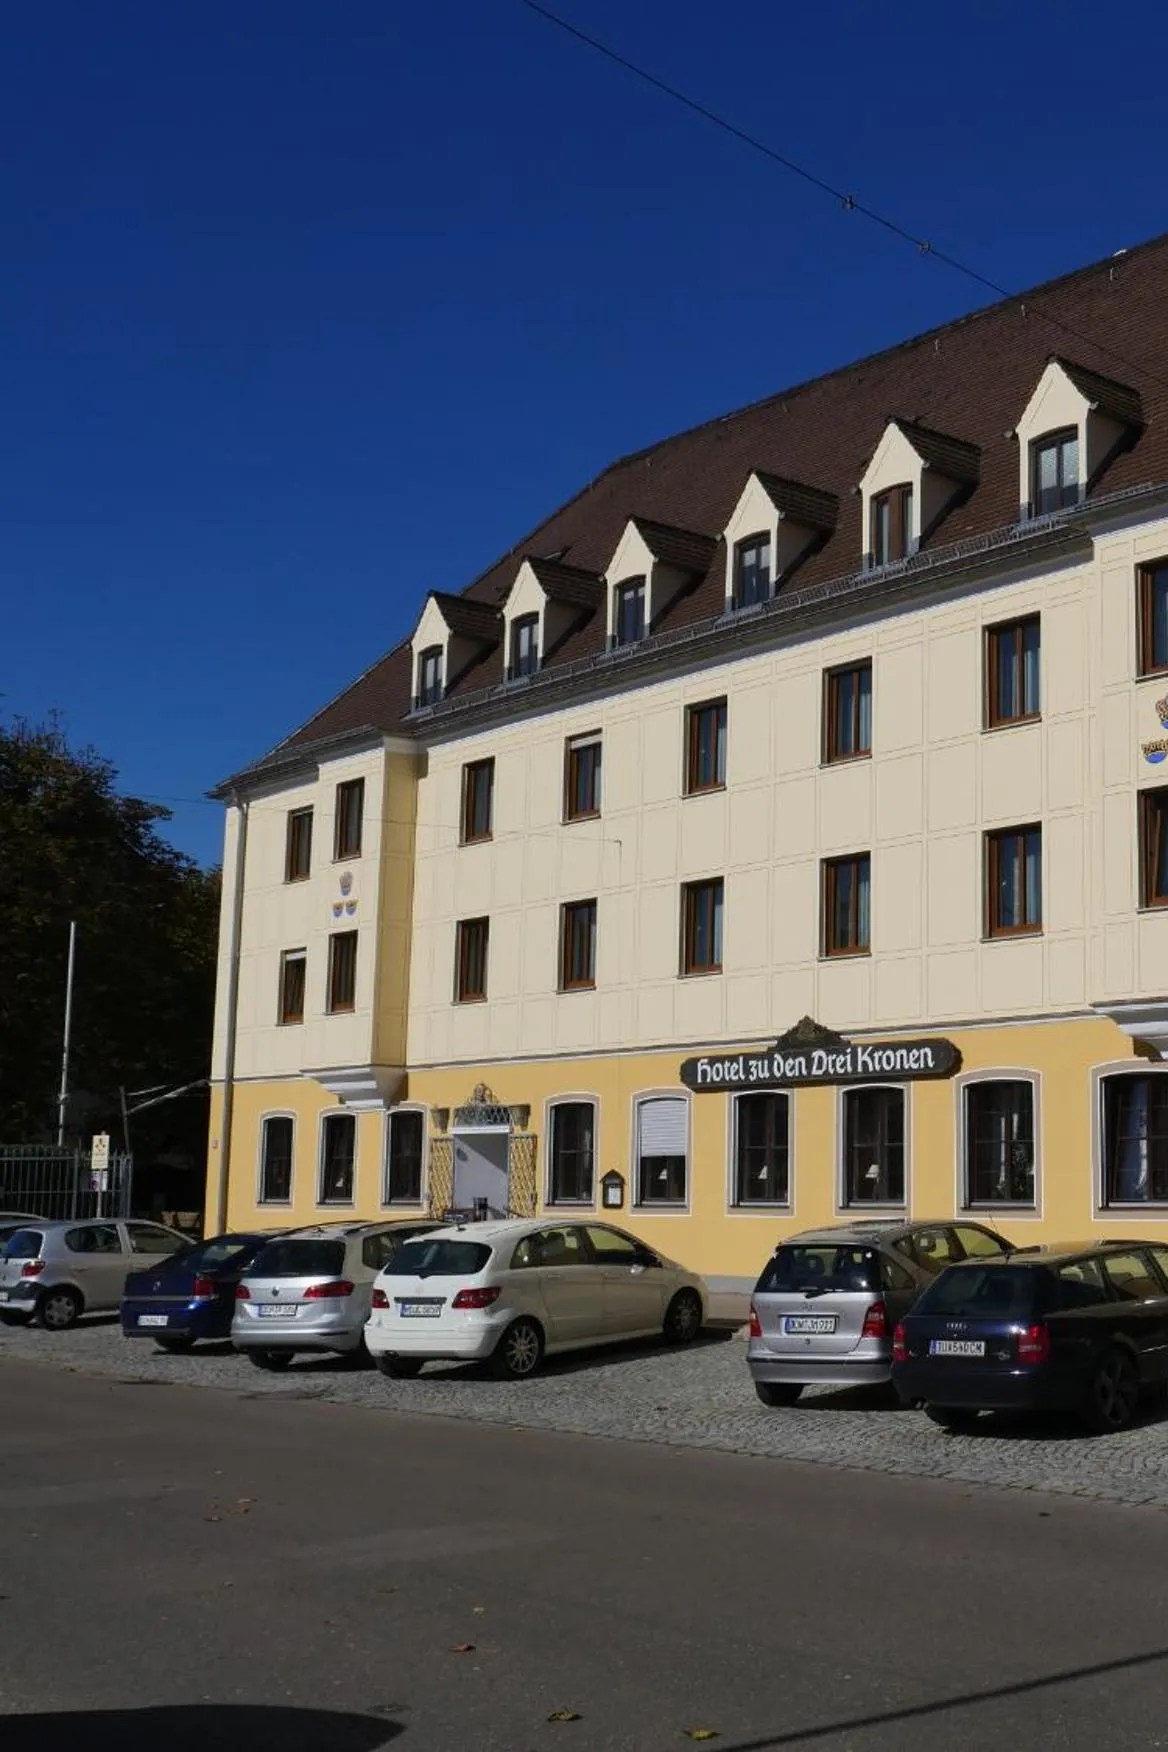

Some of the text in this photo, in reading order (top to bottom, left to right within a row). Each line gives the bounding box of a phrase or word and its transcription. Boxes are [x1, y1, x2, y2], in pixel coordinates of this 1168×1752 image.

[697, 1046, 935, 1083] Hotel zu den Drei Kronen
